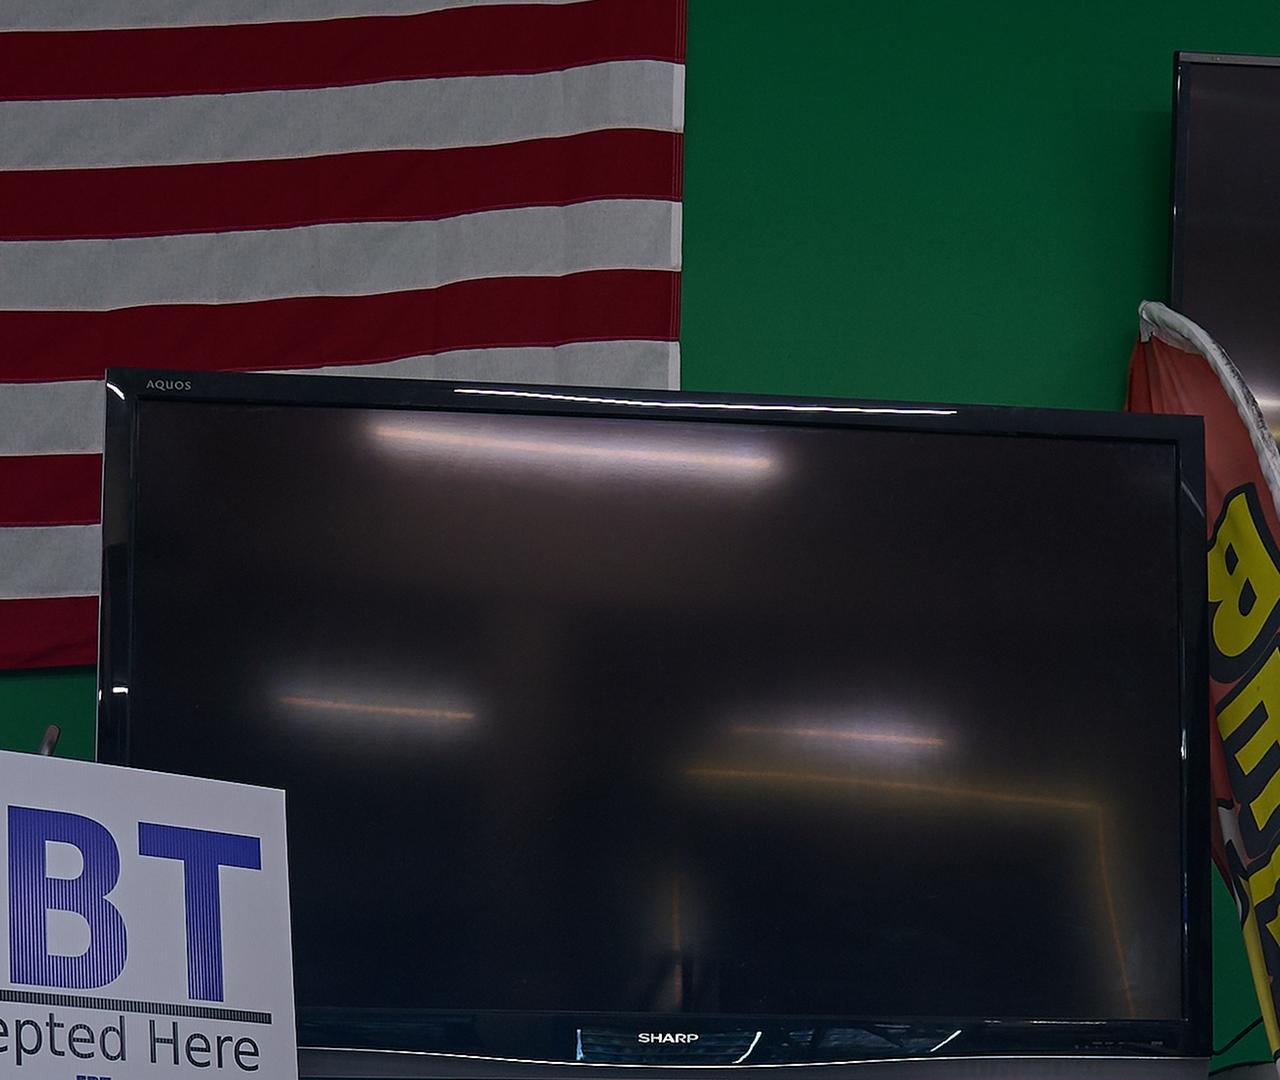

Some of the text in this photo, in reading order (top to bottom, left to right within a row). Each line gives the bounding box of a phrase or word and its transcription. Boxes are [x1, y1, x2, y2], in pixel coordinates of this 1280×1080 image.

[146, 380, 192, 391] AQUOS
[638, 1033, 699, 1044] SHARP
[149, 1020, 260, 1072] Here
